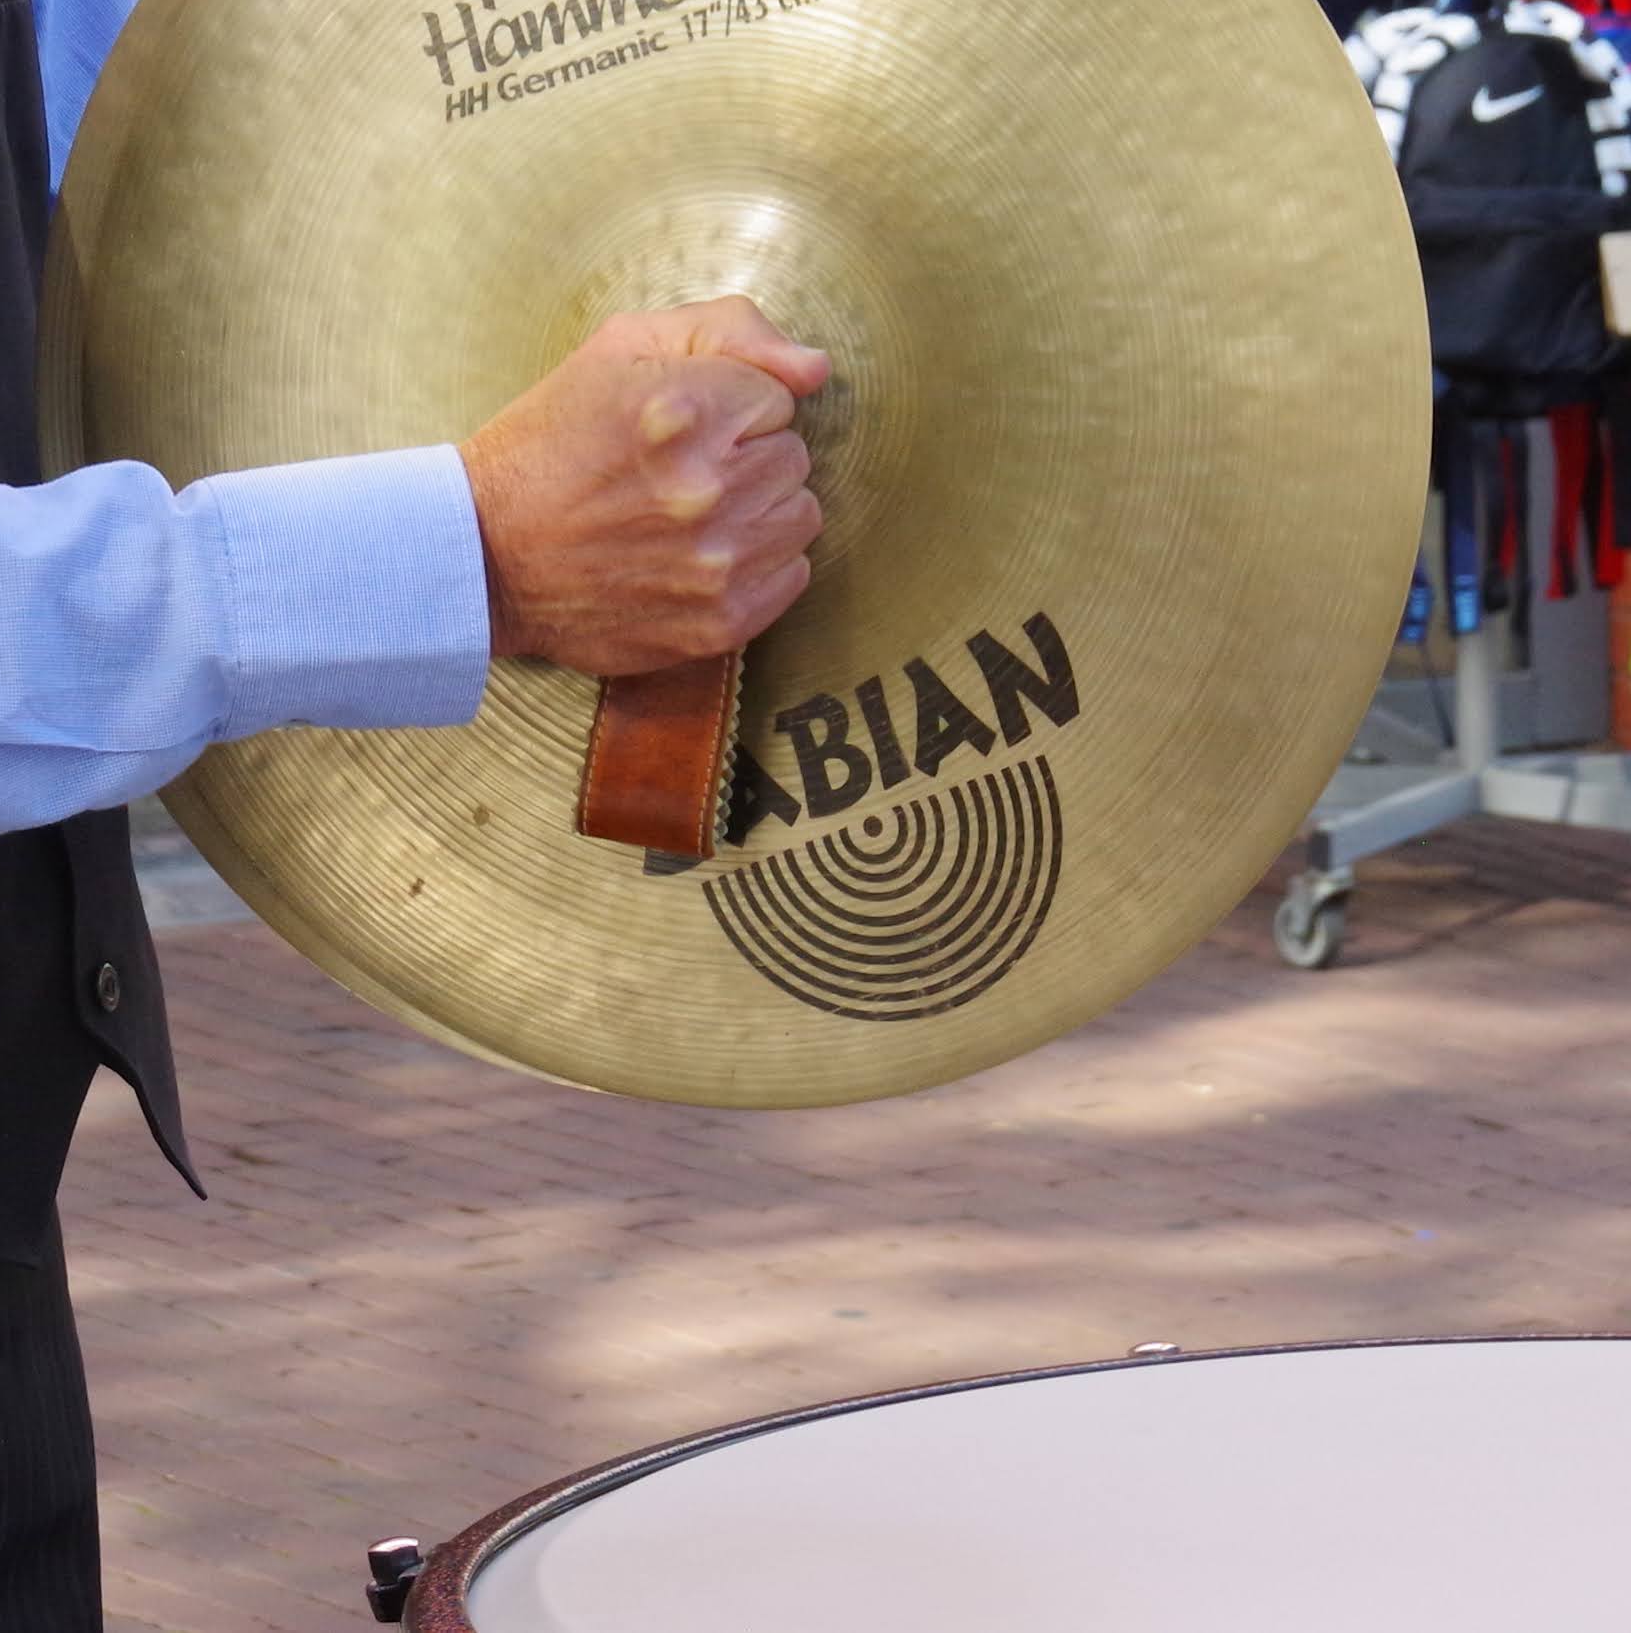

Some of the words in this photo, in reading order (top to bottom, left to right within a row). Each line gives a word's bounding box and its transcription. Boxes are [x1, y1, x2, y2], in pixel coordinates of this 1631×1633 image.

[445, 82, 489, 124] HH
[496, 28, 669, 102] Germanic
[643, 610, 1081, 876] ABIAN
